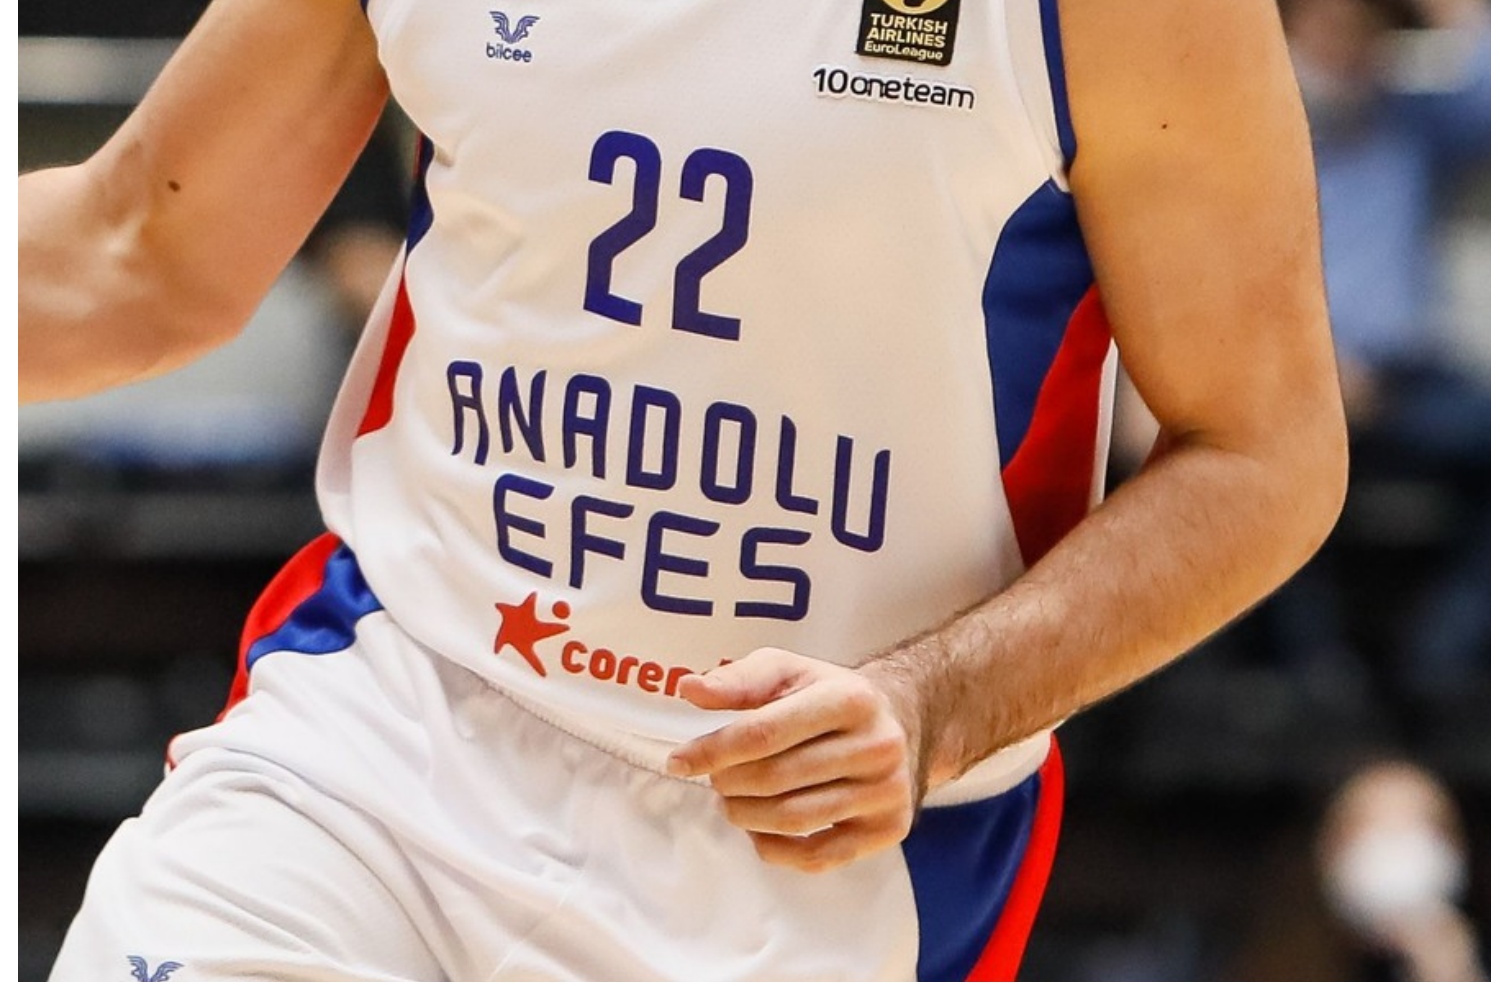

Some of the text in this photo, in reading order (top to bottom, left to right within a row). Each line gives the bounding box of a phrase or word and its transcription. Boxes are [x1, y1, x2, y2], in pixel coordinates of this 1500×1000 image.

[866, 27, 946, 48] AIRLINES
[870, 13, 948, 35] TURKISH
[486, 42, 532, 62] bilcee
[864, 41, 943, 61] EuroLeague
[583, 130, 753, 341] 22
[446, 360, 891, 552] ANADOLU
[493, 473, 812, 622] EFES
[561, 640, 733, 698] coren
